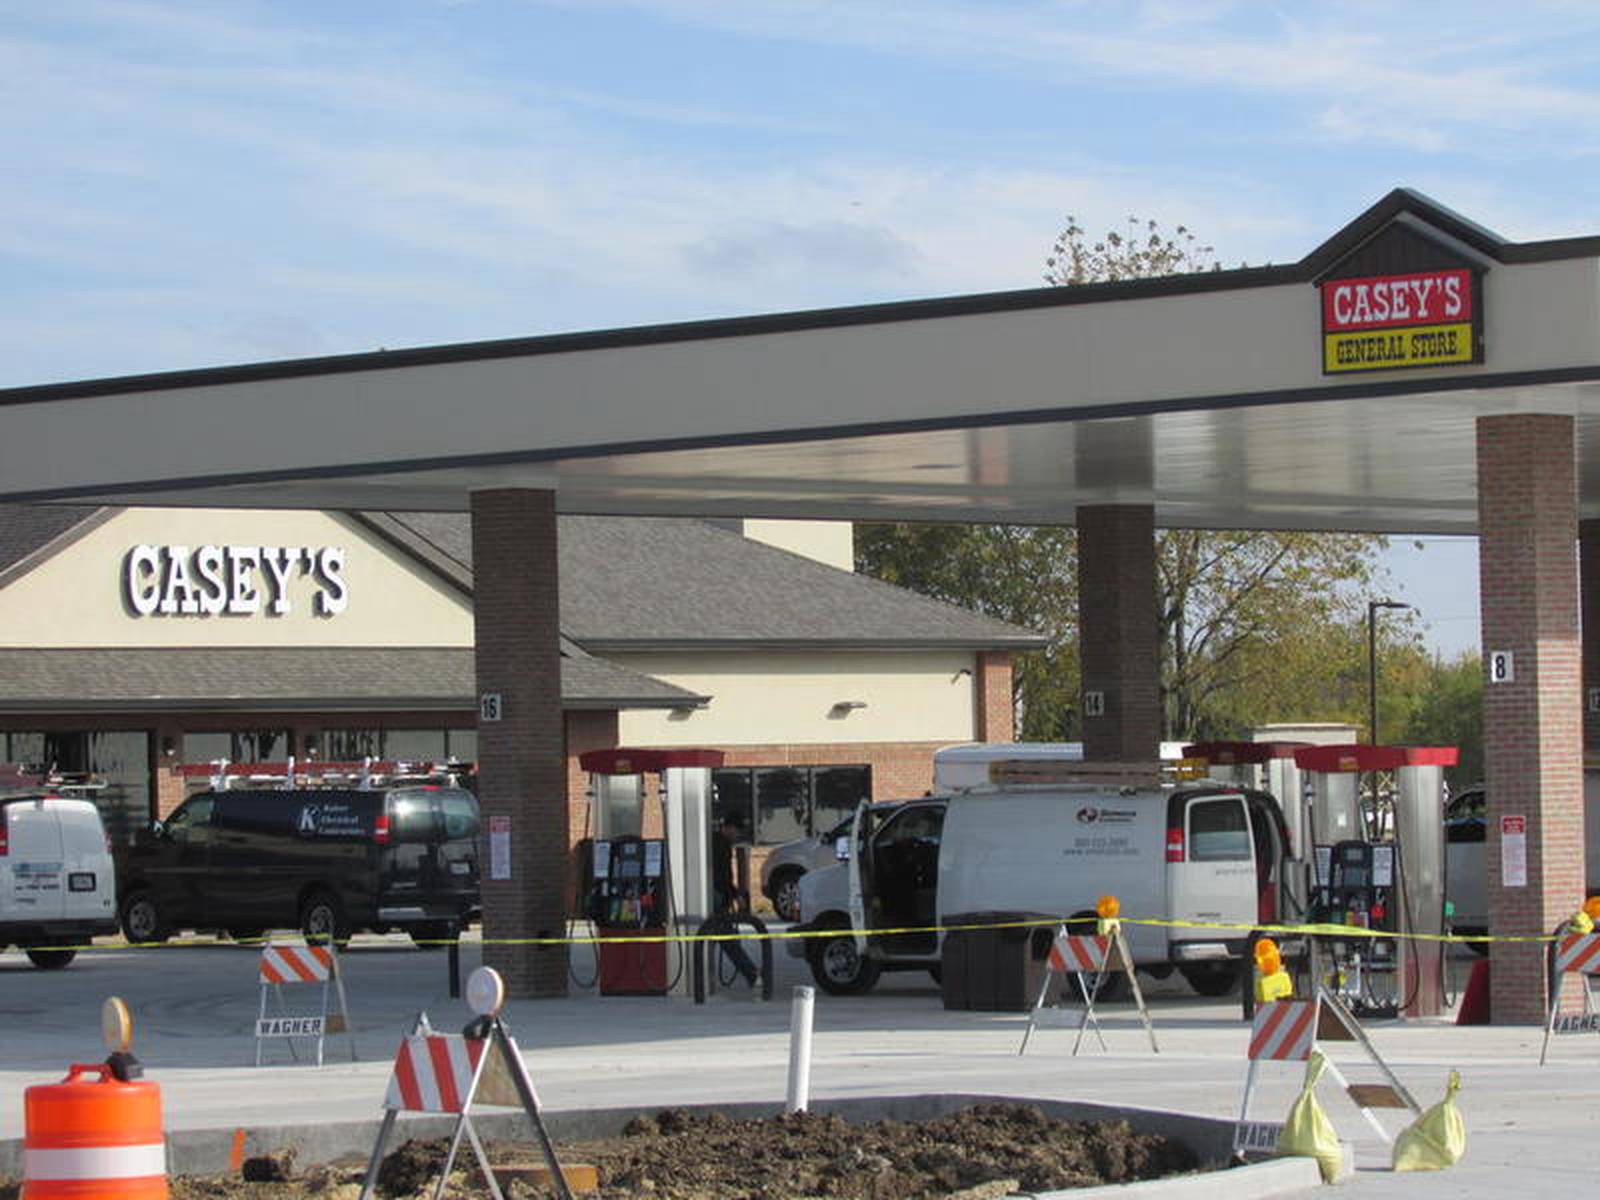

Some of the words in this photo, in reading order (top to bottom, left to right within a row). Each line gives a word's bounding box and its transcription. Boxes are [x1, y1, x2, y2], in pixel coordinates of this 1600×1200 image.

[1334, 276, 1462, 324] CASEY'S
[1337, 335, 1406, 364] GENERAL
[1411, 331, 1457, 359] STORE
[122, 544, 349, 617] CASEY'S
[1496, 654, 1507, 679] 8
[483, 697, 497, 719] 16
[260, 1018, 321, 1035] WAGNER
